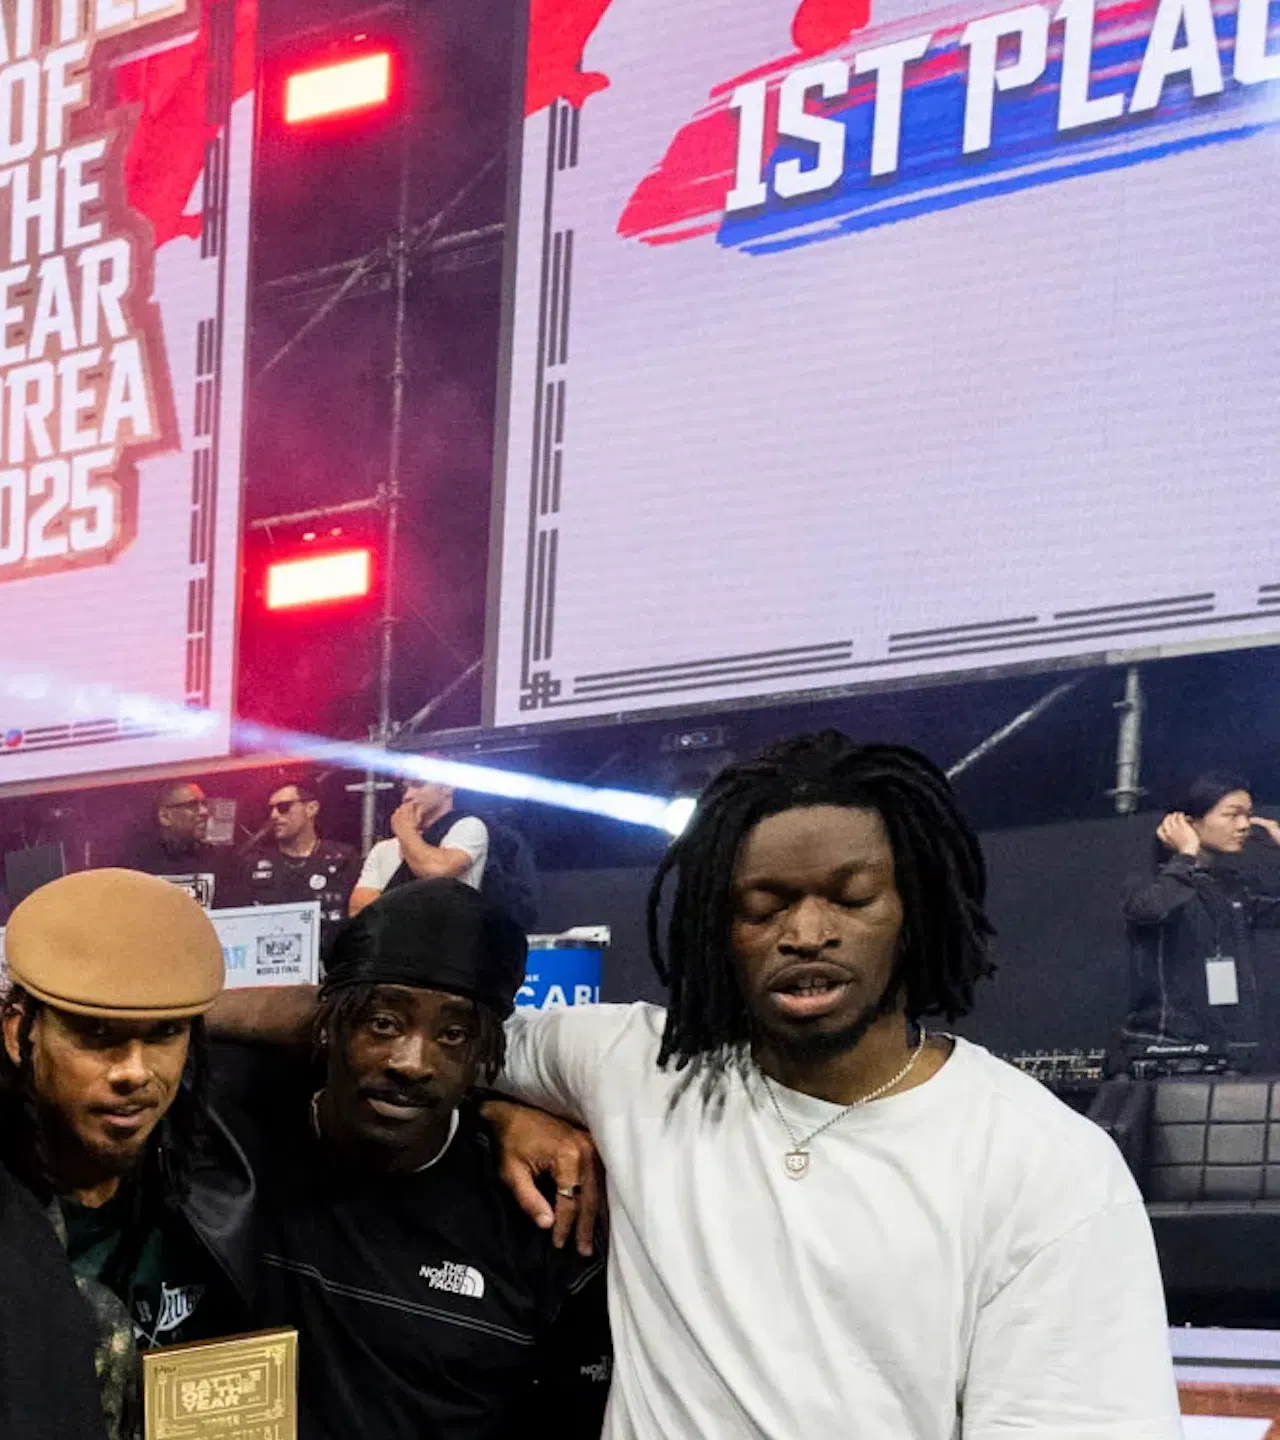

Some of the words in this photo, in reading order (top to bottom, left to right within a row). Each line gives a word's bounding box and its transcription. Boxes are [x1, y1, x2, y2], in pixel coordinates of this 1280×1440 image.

[726, 34, 932, 212] 1ST
[419, 1264, 463, 1287] NORTH
[442, 1260, 467, 1277] THE
[428, 1277, 460, 1293] FACE
